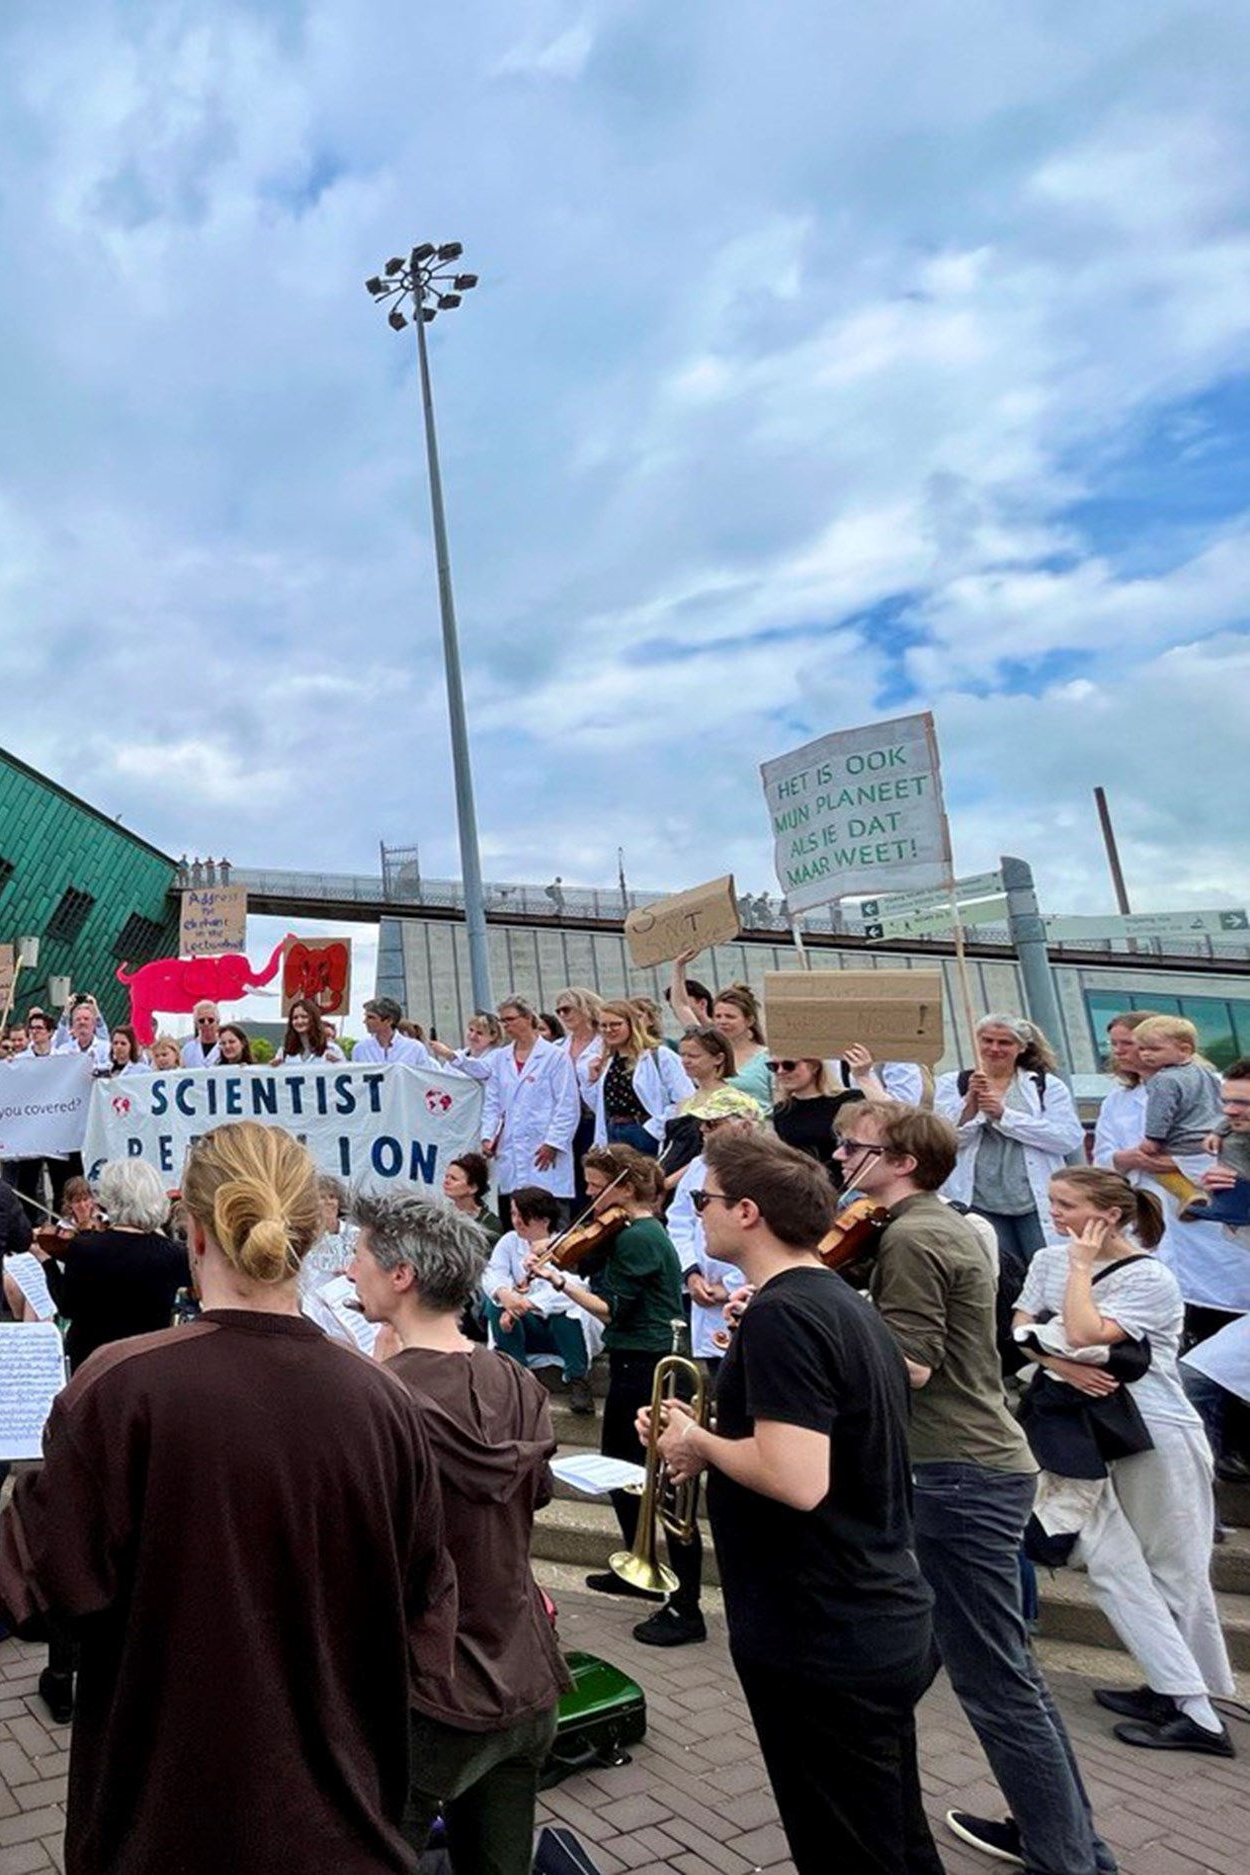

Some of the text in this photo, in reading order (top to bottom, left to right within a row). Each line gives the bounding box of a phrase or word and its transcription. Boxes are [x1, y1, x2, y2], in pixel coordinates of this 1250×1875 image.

[777, 746, 907, 799] HET IS OOK
[816, 775, 928, 814] PLANEET
[790, 832, 818, 858] ALS
[848, 812, 900, 838] DAT
[787, 838, 917, 887] MAAR WEET!
[24, 1099, 82, 1116] covered?
[151, 1073, 385, 1116] SCIENTIST
